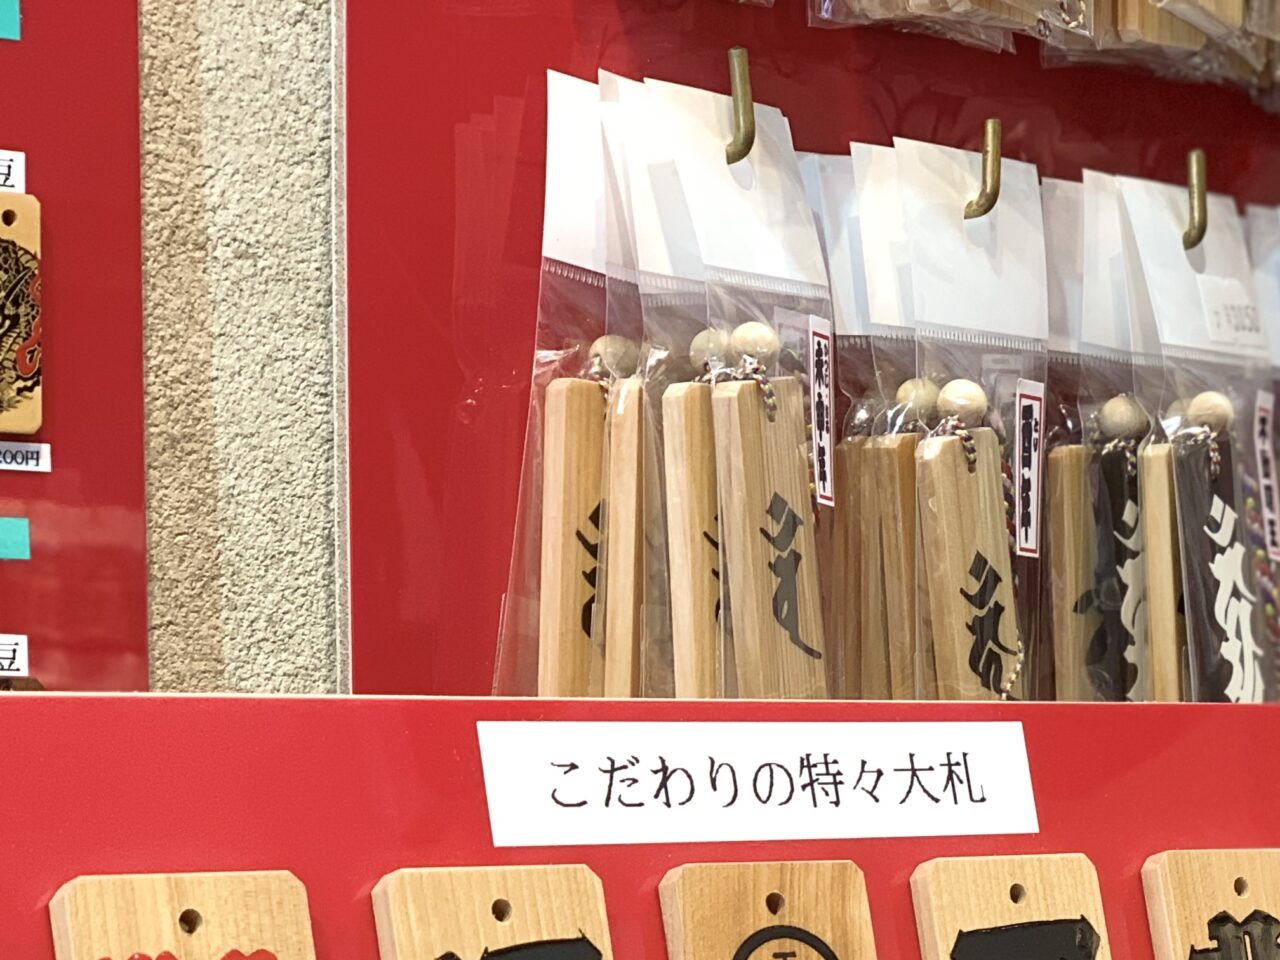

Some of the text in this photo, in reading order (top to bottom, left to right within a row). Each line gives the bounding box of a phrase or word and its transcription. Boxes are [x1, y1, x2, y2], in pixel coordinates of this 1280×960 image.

[0, 449, 40, 467] 00円
[549, 751, 988, 809] こだわりの特々大札
